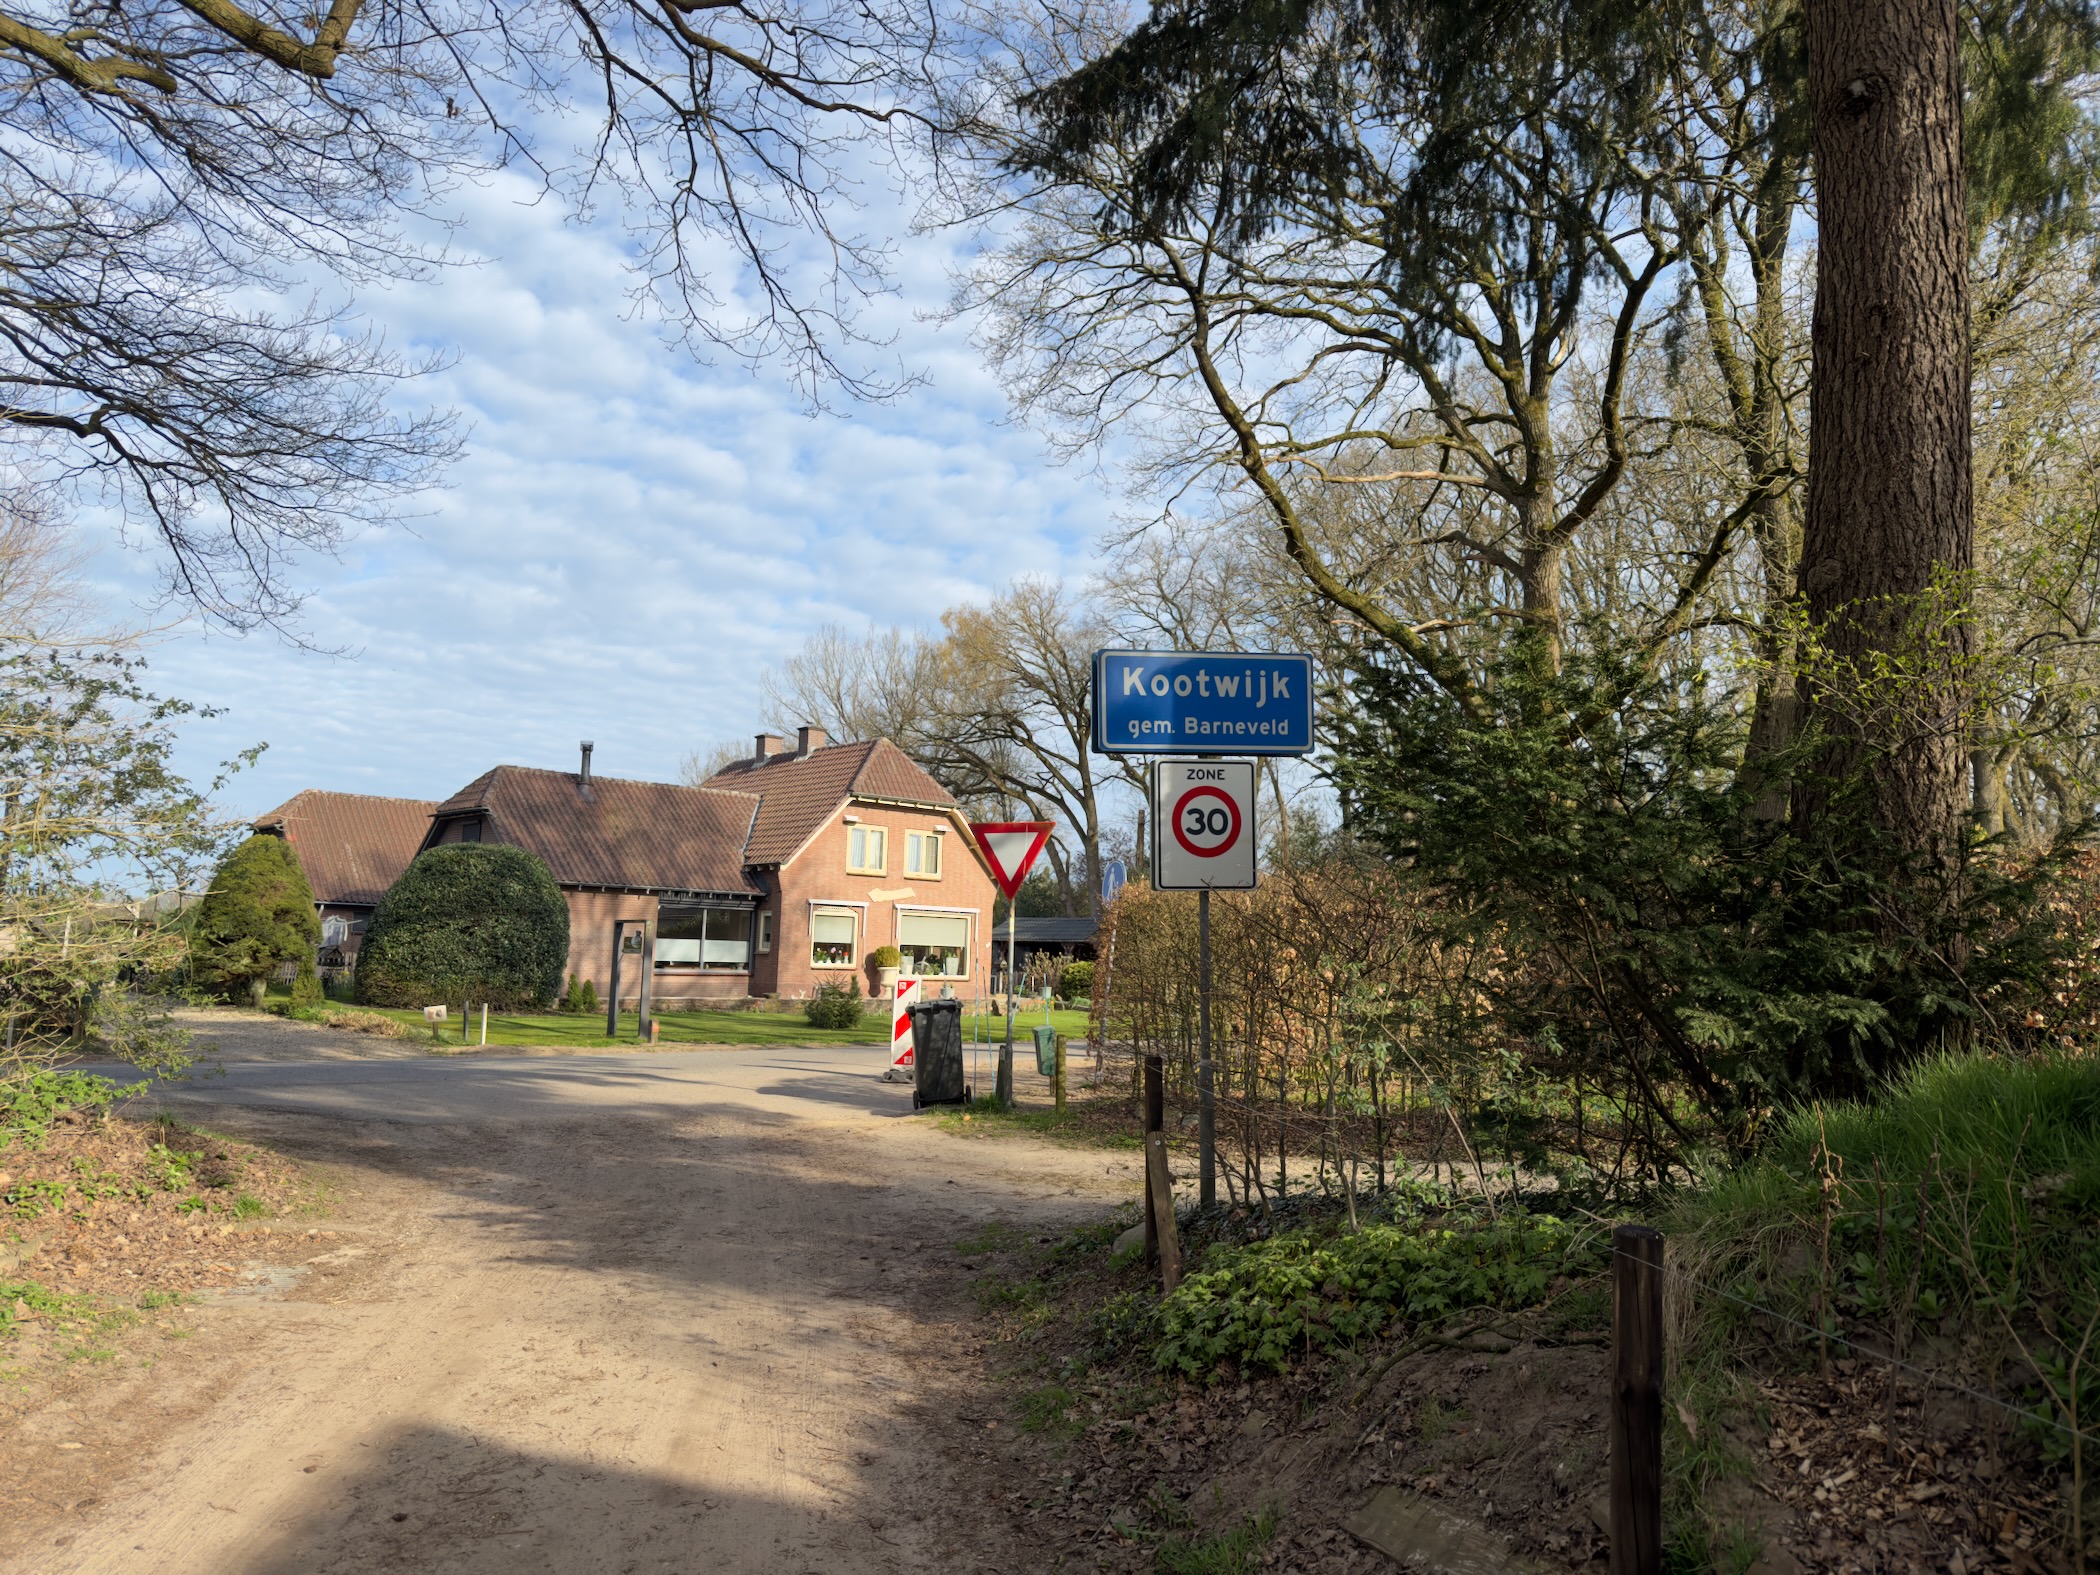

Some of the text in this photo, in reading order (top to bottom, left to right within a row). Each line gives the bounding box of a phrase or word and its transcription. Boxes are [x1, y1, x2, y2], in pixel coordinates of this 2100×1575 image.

[1123, 667, 1290, 708] Kootwijk
[1128, 717, 1289, 738] gem. Barneveld
[1187, 769, 1225, 780] ZONE
[1185, 808, 1229, 836] 30
